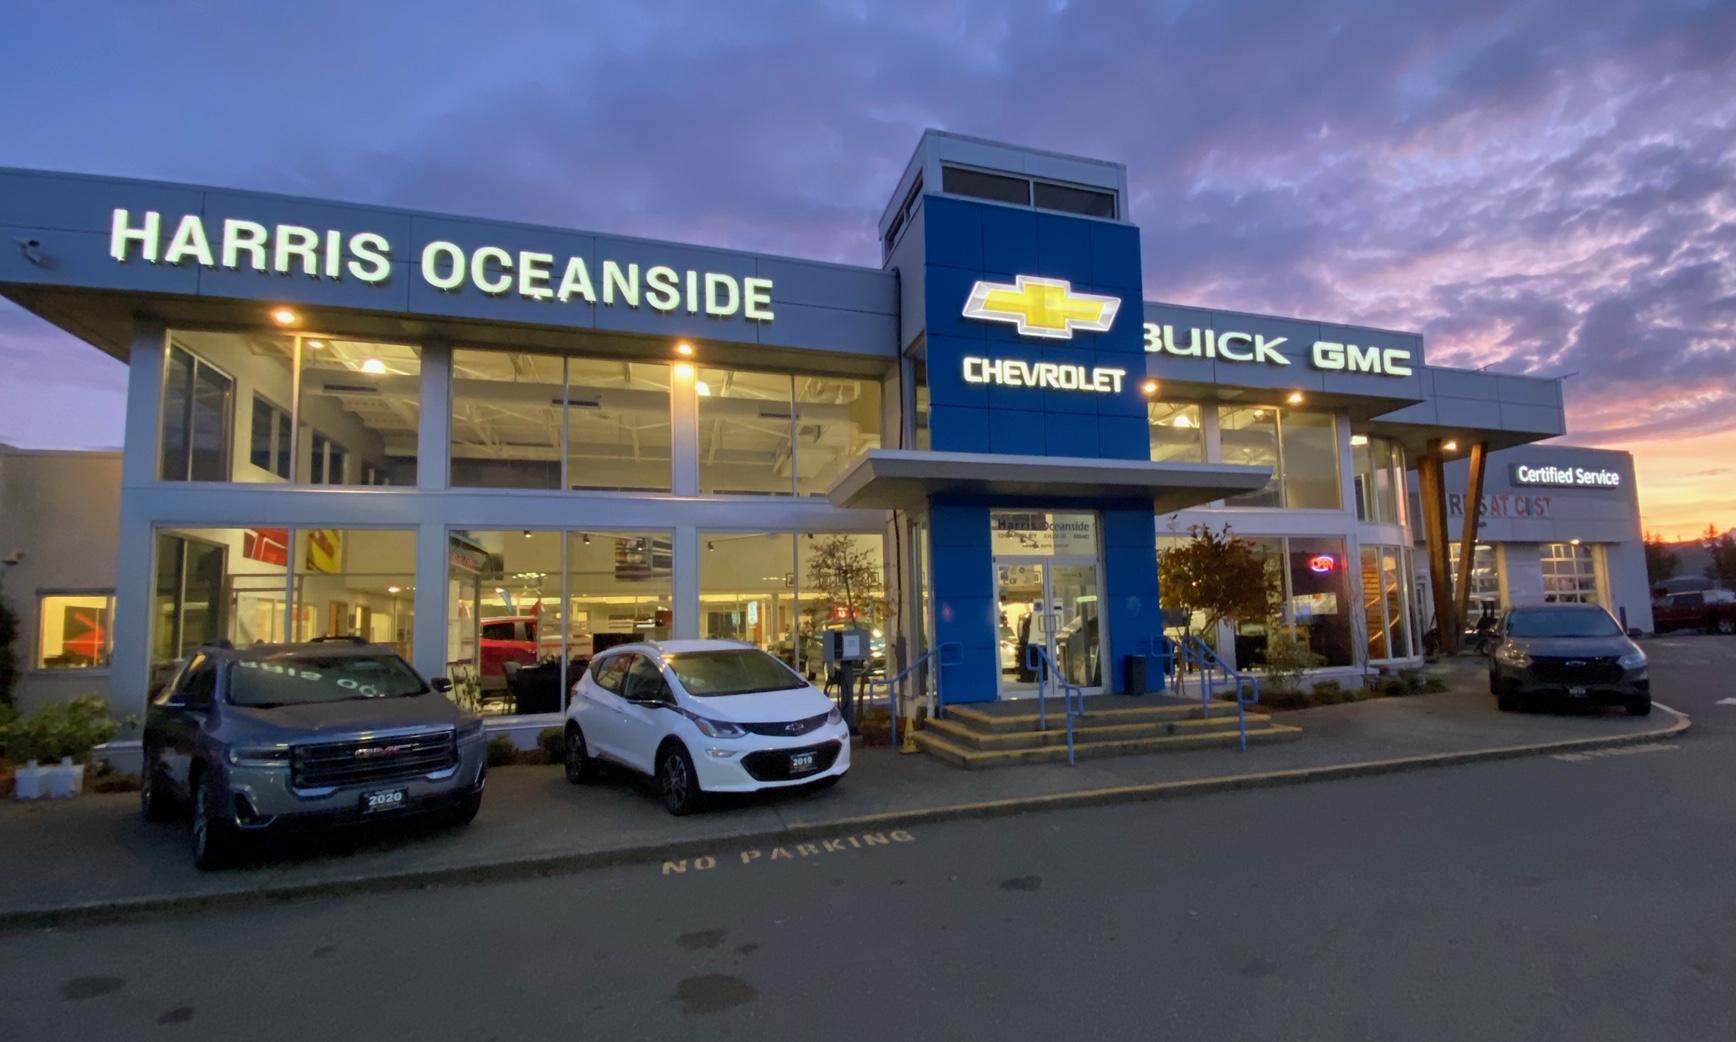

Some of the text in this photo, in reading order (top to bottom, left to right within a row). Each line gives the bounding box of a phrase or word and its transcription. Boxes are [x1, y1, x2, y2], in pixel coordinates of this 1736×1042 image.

[110, 208, 775, 321] HARRIS OCEANSIDE
[1143, 322, 1413, 376] BUICK GMC
[962, 356, 1126, 394] CHEVROLET
[1518, 464, 1620, 487] Certified Service
[792, 756, 813, 767] 2019
[368, 791, 403, 806] 2020
[661, 829, 915, 875] NO PARKING
